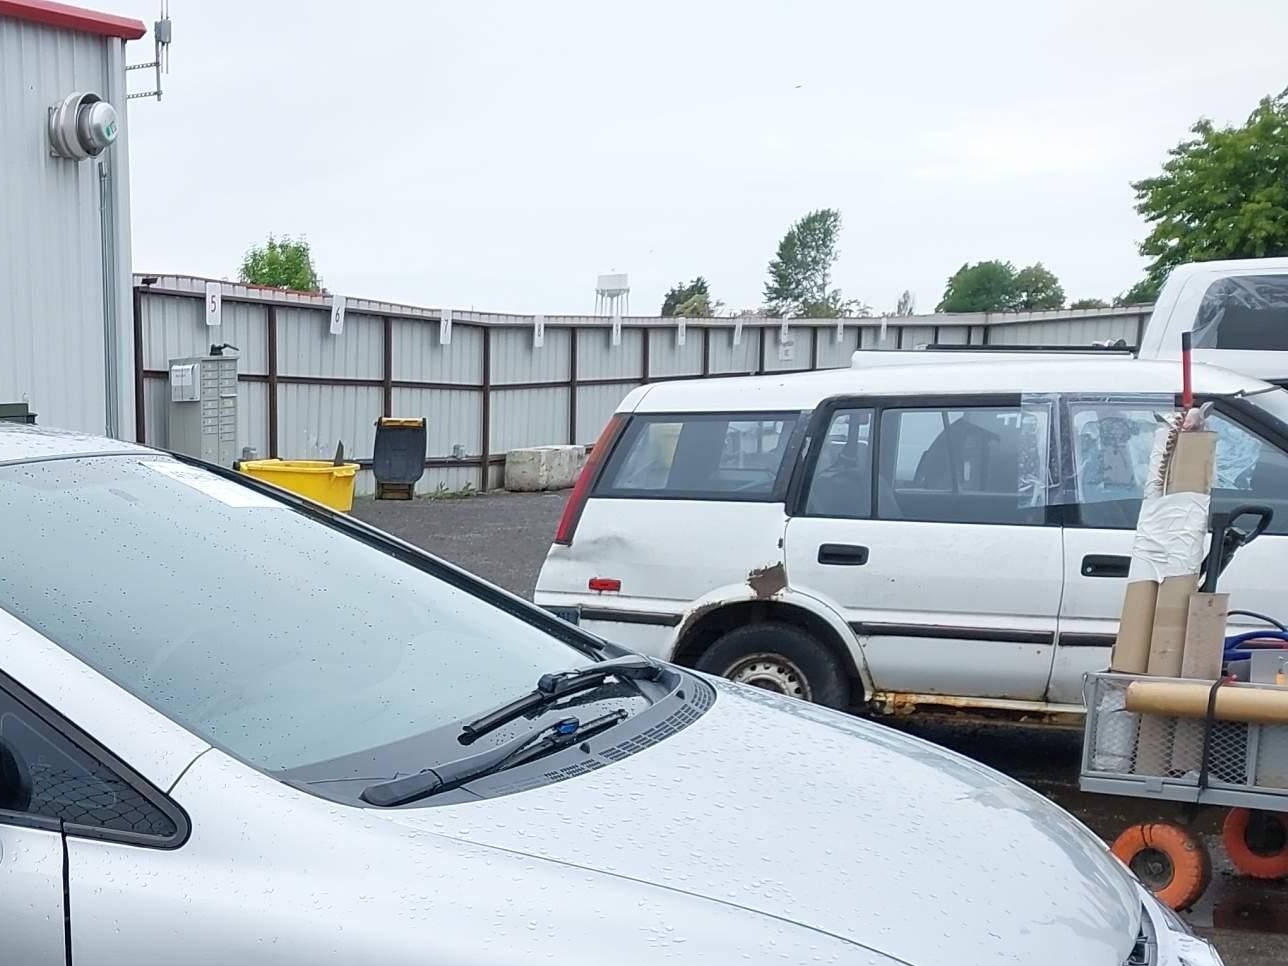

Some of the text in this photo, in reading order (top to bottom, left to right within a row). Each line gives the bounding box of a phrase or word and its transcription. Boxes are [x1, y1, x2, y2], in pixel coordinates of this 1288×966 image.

[210, 294, 217, 313] 5
[334, 306, 341, 324] 6
[444, 318, 449, 335] 7
